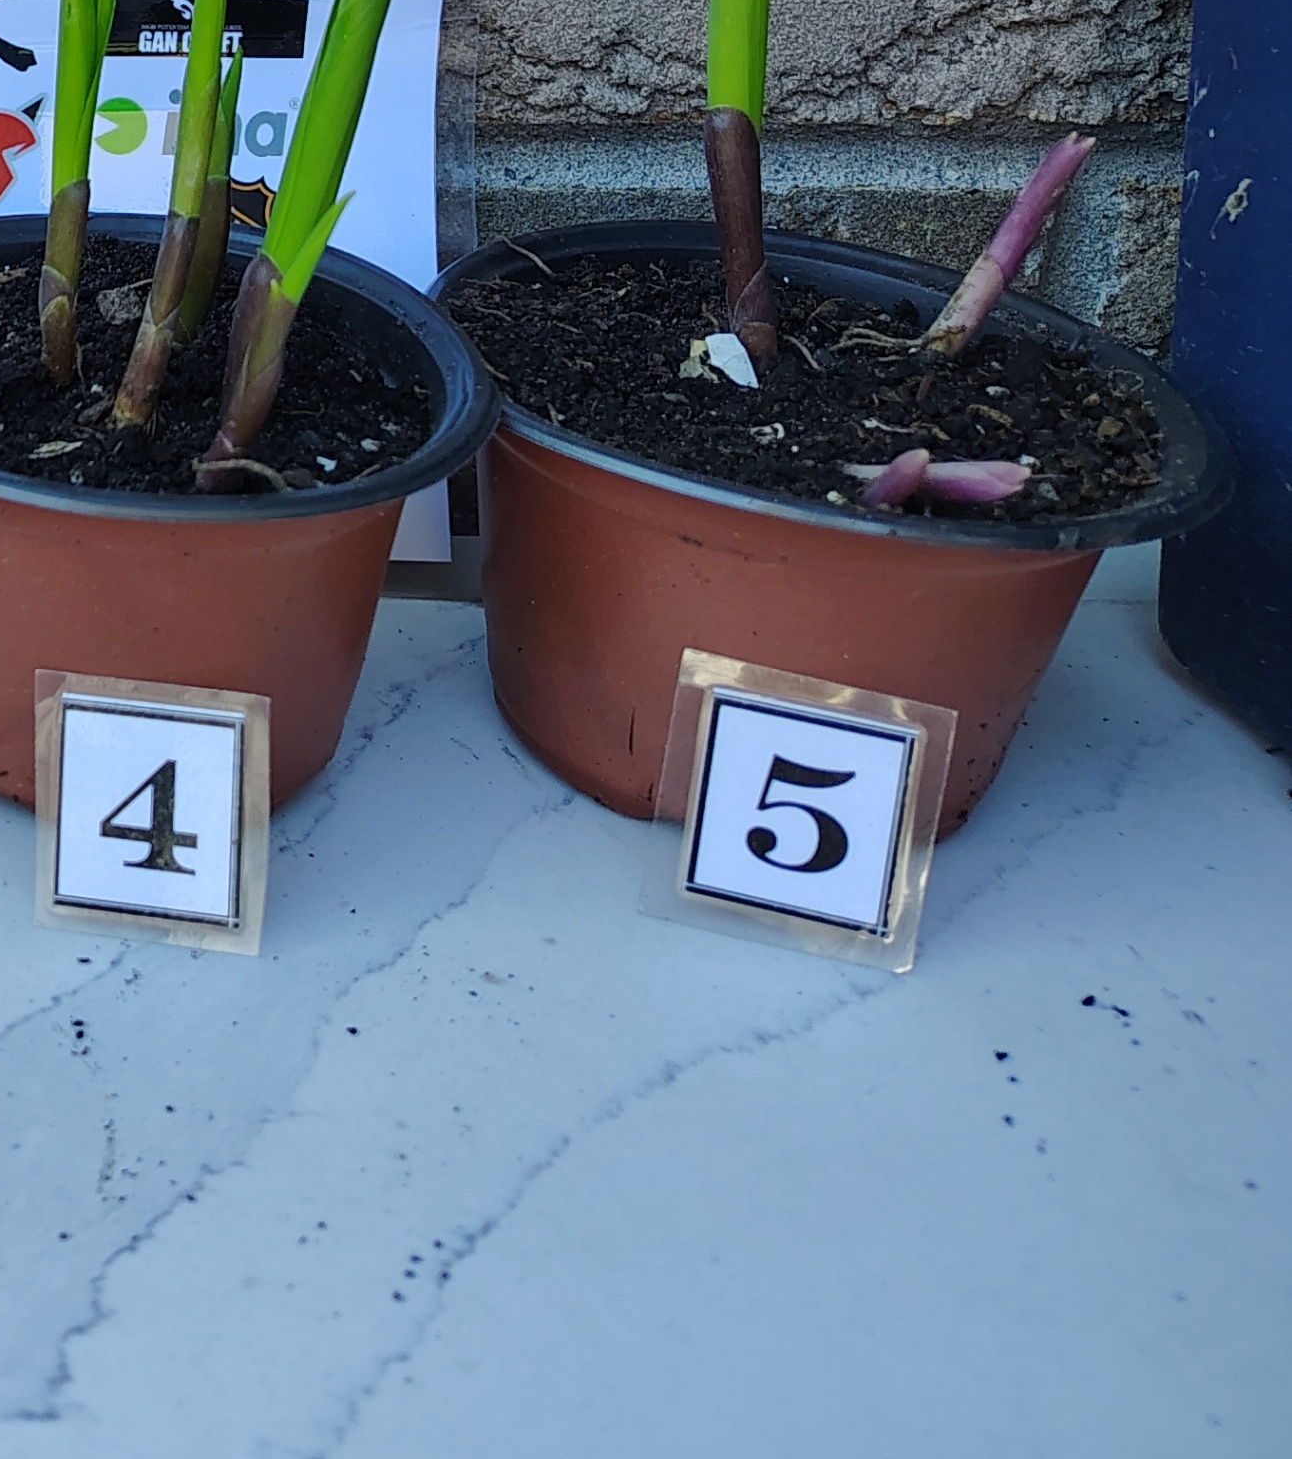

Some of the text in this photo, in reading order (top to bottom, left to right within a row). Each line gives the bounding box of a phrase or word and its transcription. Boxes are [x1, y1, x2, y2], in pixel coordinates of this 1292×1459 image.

[139, 31, 178, 53] GAN
[100, 760, 197, 875] 4
[746, 755, 856, 874] 5
